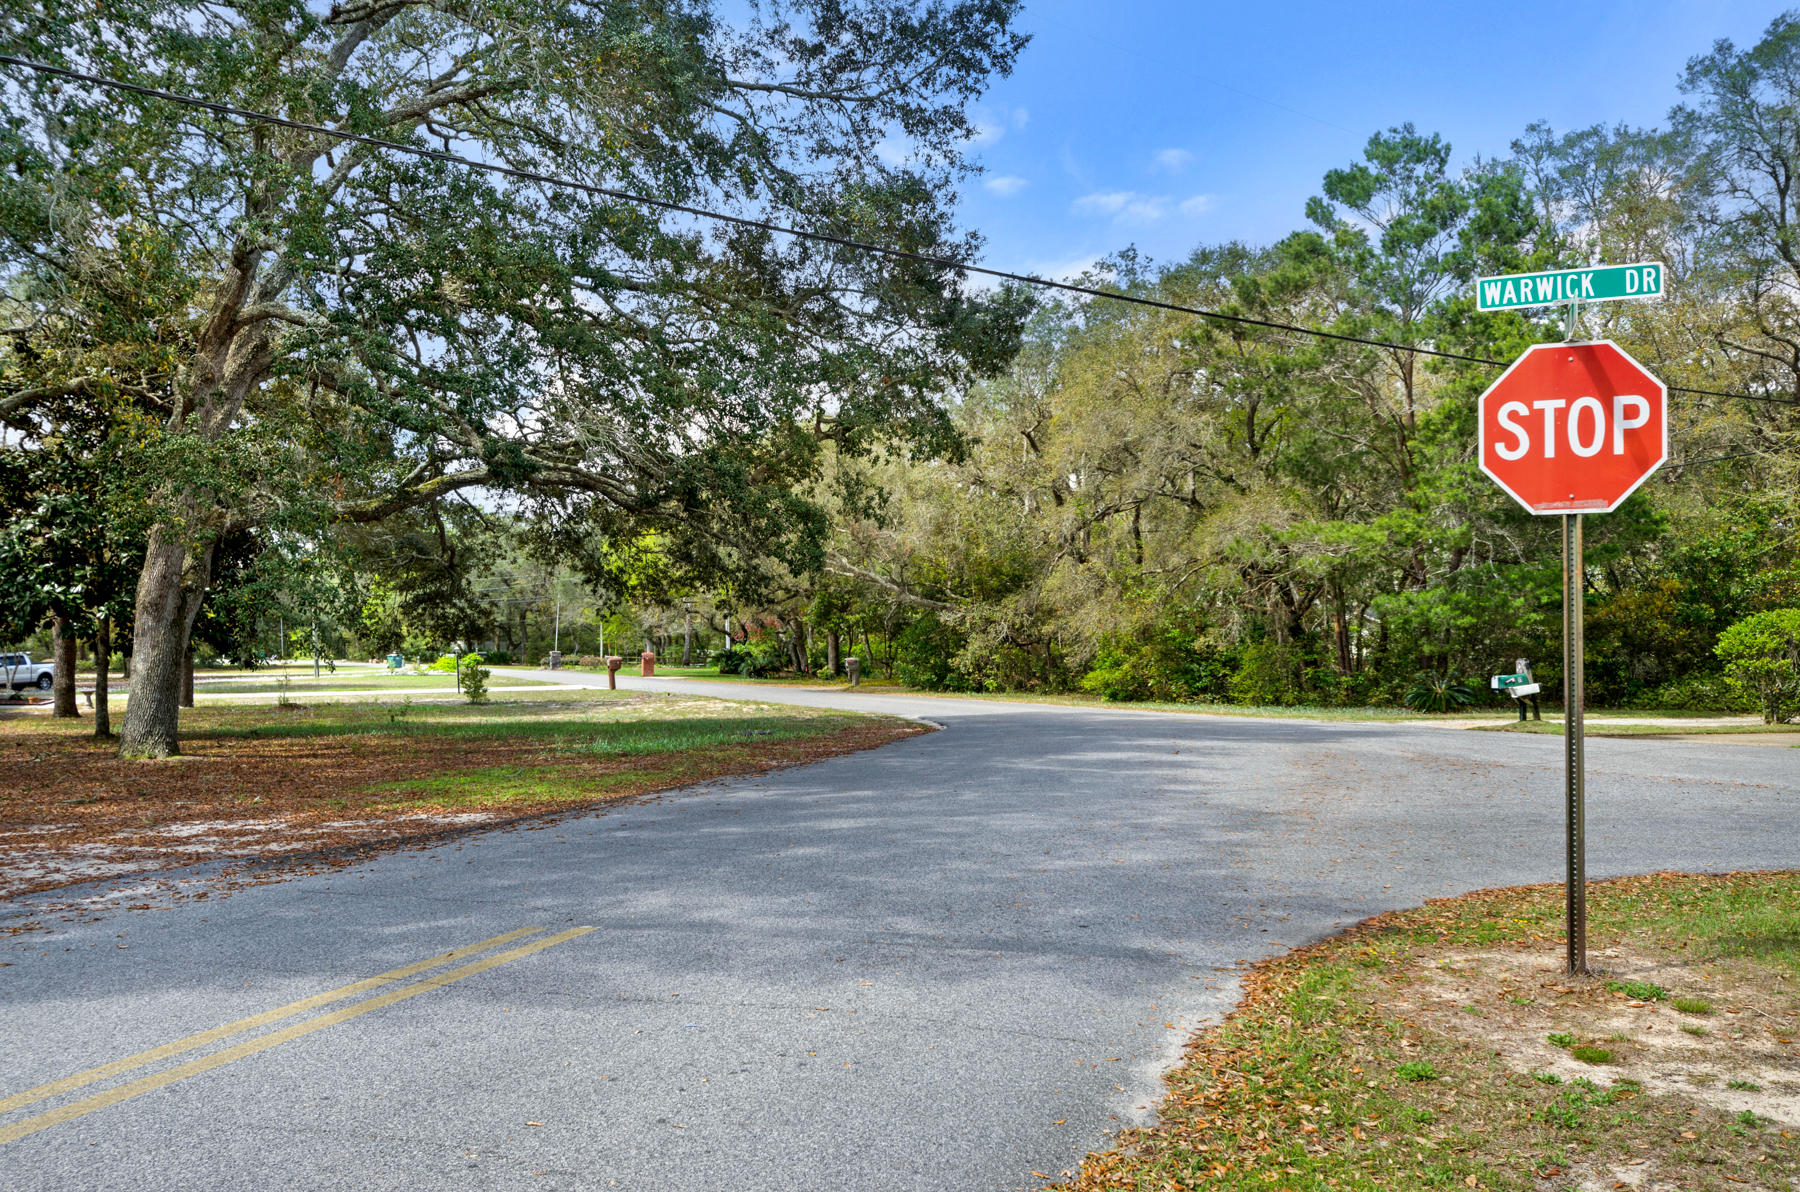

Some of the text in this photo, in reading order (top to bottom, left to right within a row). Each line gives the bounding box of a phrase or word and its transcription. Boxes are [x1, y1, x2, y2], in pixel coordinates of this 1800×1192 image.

[1484, 268, 1656, 306] WARWICK DR
[1494, 395, 1650, 461] STOP
